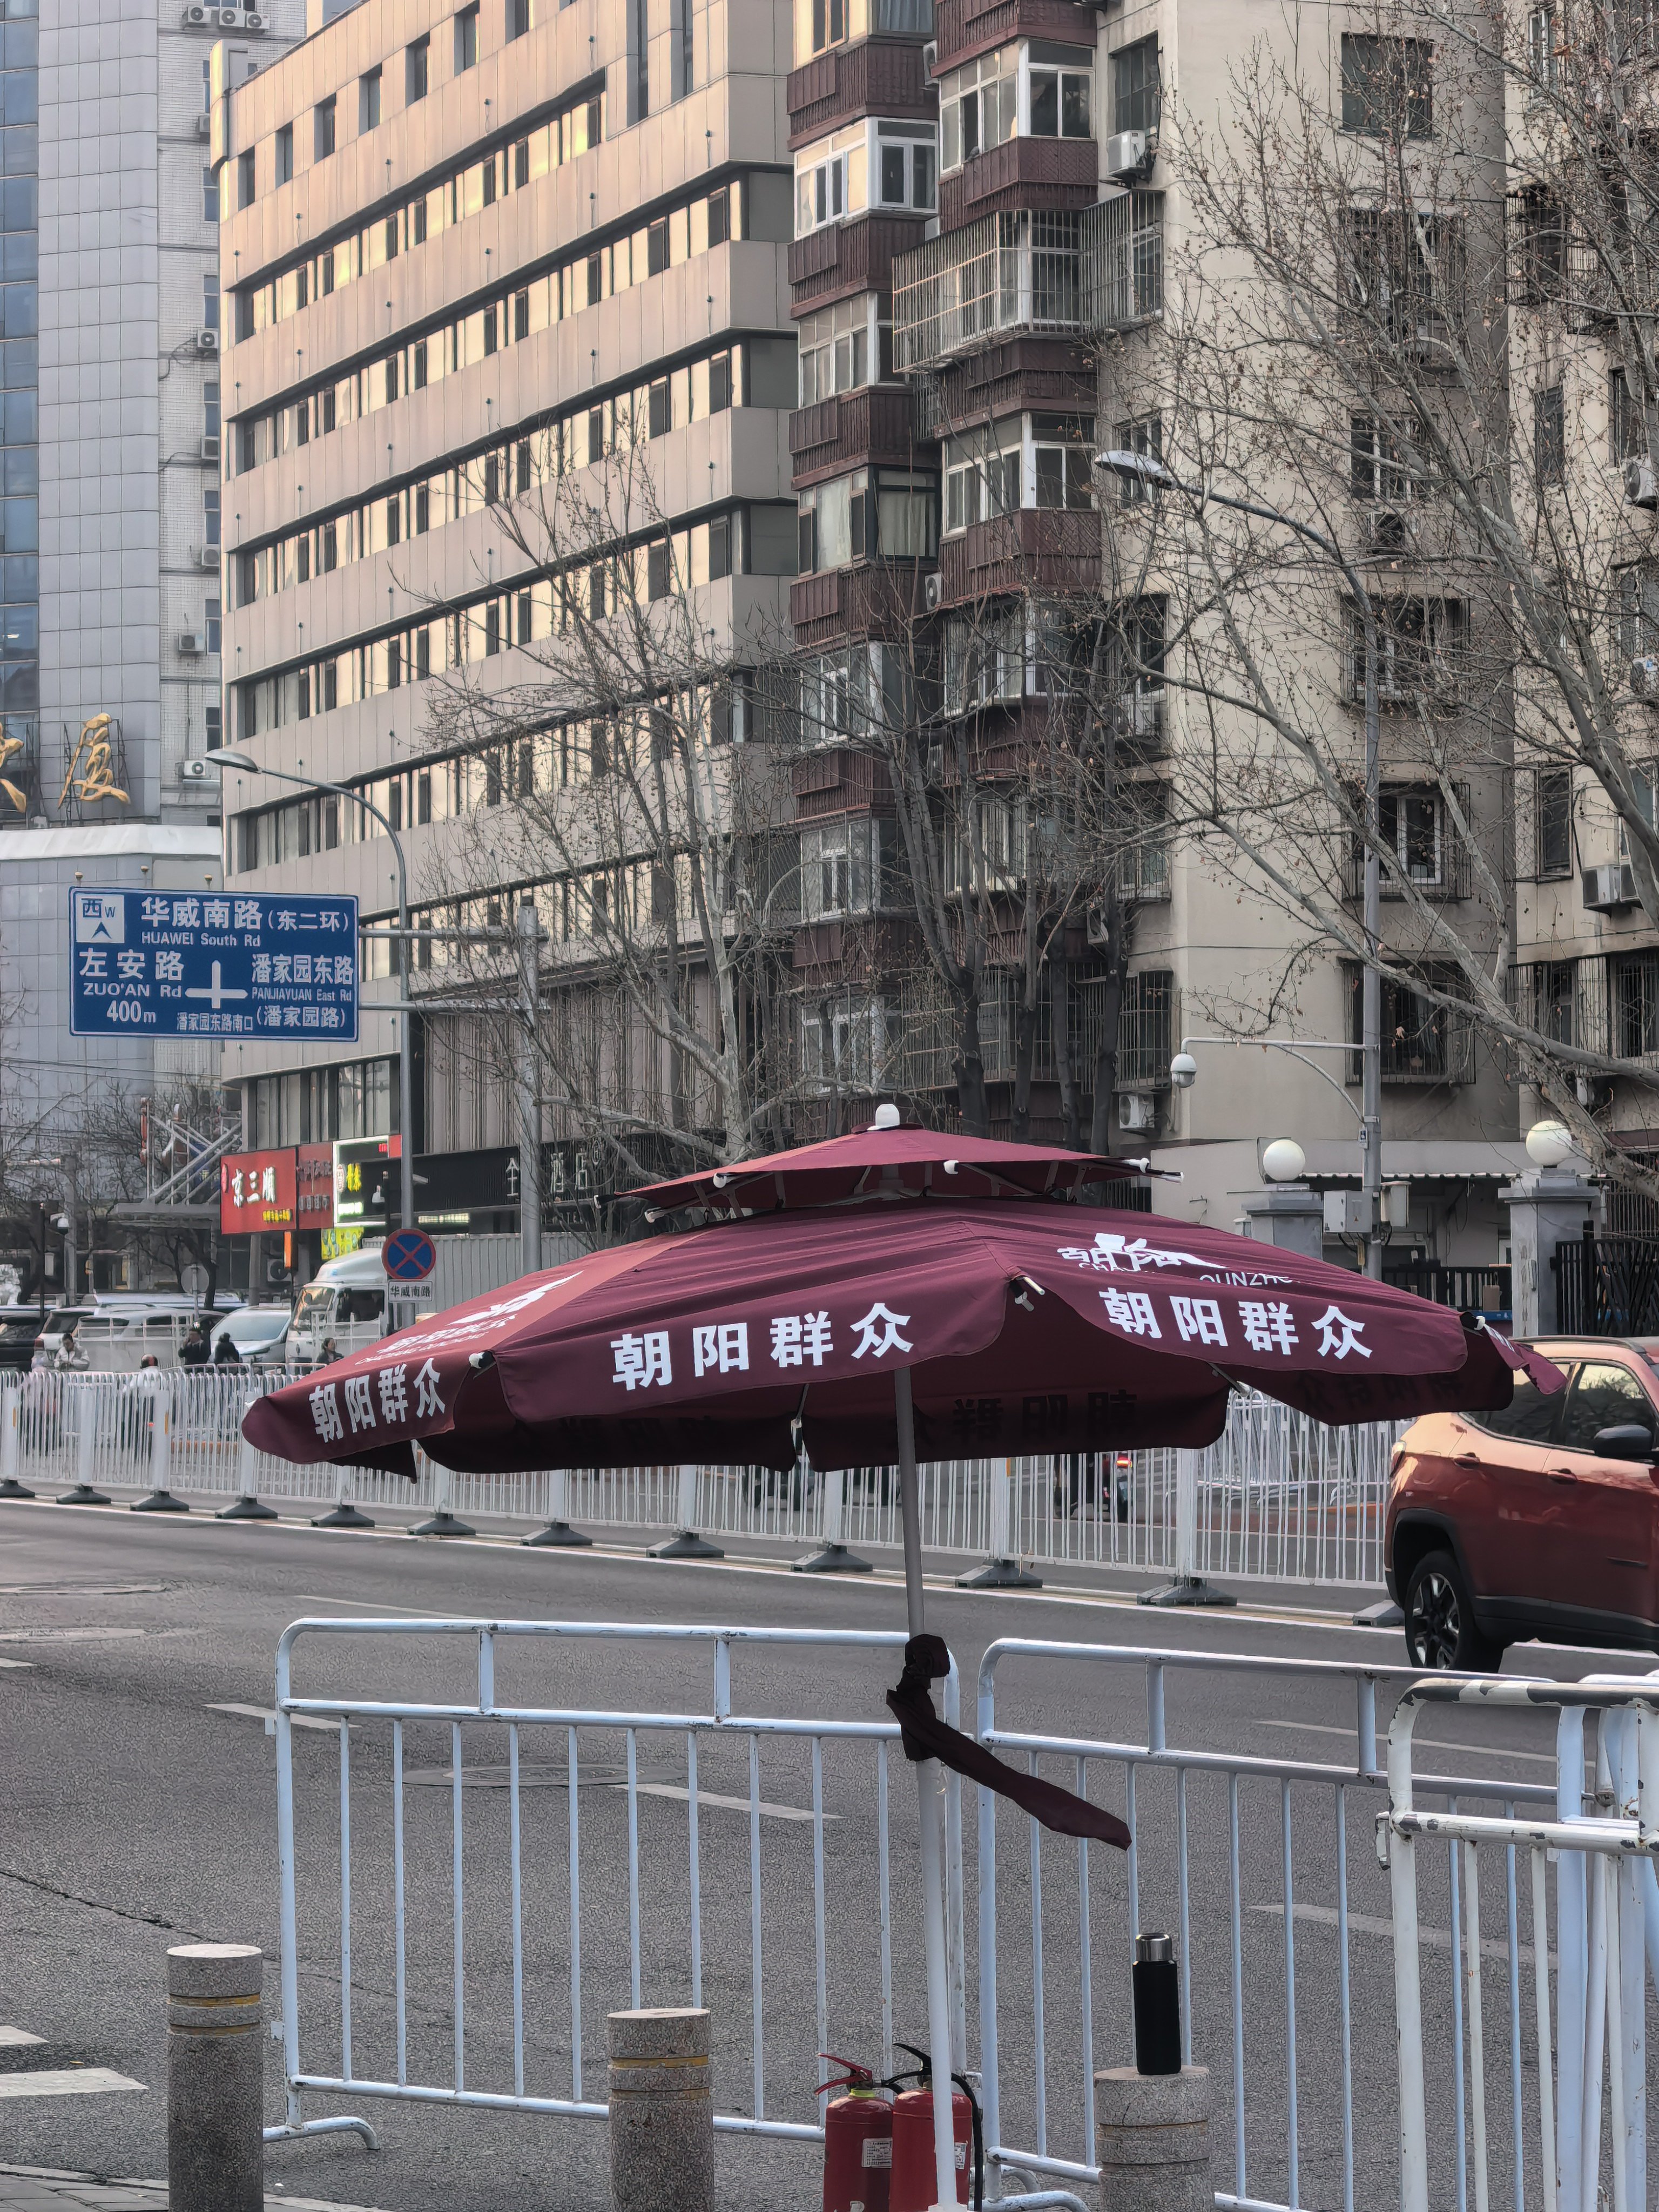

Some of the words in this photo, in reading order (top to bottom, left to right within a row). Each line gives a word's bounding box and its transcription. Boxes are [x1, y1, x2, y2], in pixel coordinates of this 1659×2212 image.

[81, 898, 102, 918] 西
[105, 906, 116, 918] W
[141, 896, 263, 929] 华威南路
[141, 932, 193, 946] HUAWEI
[201, 933, 237, 947] South
[244, 935, 260, 947] Rd
[79, 947, 185, 981] 左安路
[251, 953, 354, 984] 潘家园东路
[83, 983, 150, 997] ZUO'AN
[160, 984, 181, 998] Rd
[252, 987, 312, 1001] PANJIAYUAN
[316, 989, 336, 1002] East
[340, 989, 352, 1002] Rd
[177, 1012, 253, 1032] 潘家园东路南口
[505, 1152, 588, 1196] 全酒店
[390, 1285, 430, 1297] 华威南路
[1099, 1287, 1373, 1360] 朝阳群众
[610, 1303, 914, 1391] 朝阳群众
[308, 1358, 446, 1443] 朝阳群众
